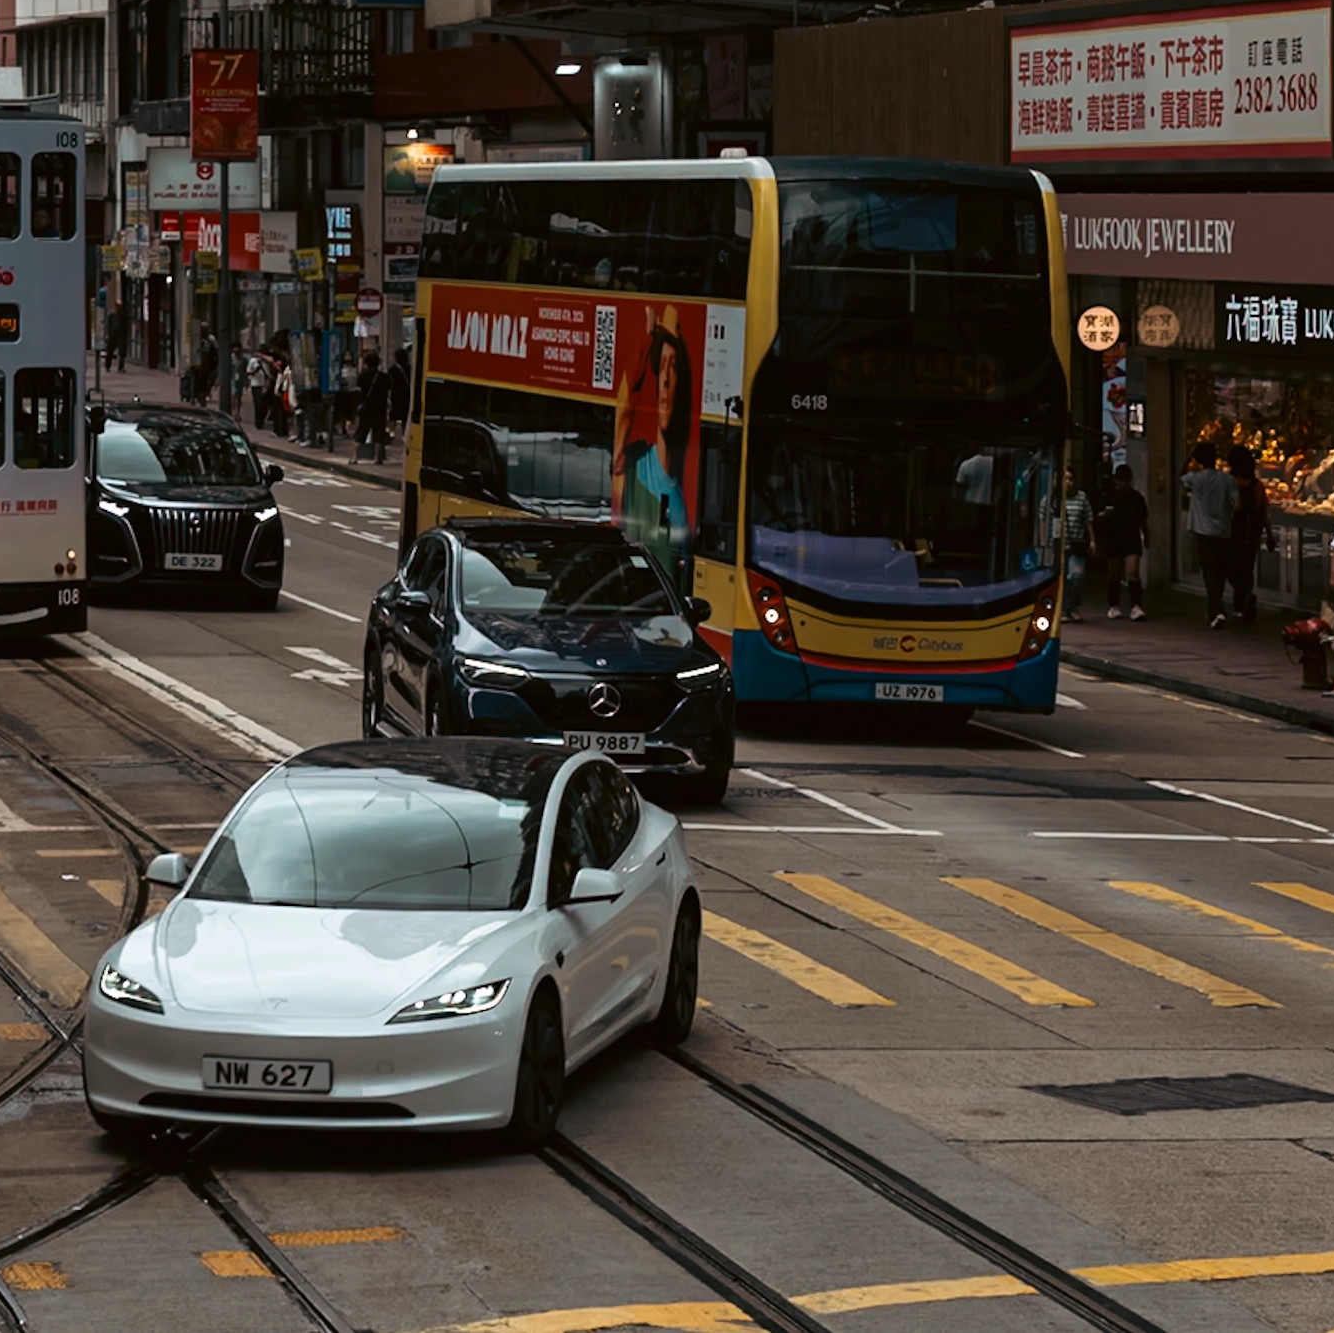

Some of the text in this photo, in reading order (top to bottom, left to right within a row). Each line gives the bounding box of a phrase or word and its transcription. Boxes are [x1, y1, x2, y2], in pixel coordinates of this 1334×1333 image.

[210, 54, 243, 86] 77
[1235, 72, 1317, 114] 2382 3688
[56, 132, 78, 148] 108
[1074, 217, 1143, 251] LUKFOOK
[1145, 219, 1235, 258] JEWELLERY
[1225, 293, 1299, 346] 六福珠寶
[448, 308, 529, 359] JASON MRAZ
[791, 394, 828, 410] 6418
[172, 556, 215, 567] DE 322
[57, 586, 81, 607] 108
[918, 638, 964, 652] Citybus
[883, 685, 936, 699] UZ 1976
[569, 735, 639, 750] PU 9887
[216, 1061, 315, 1087] NW 627
